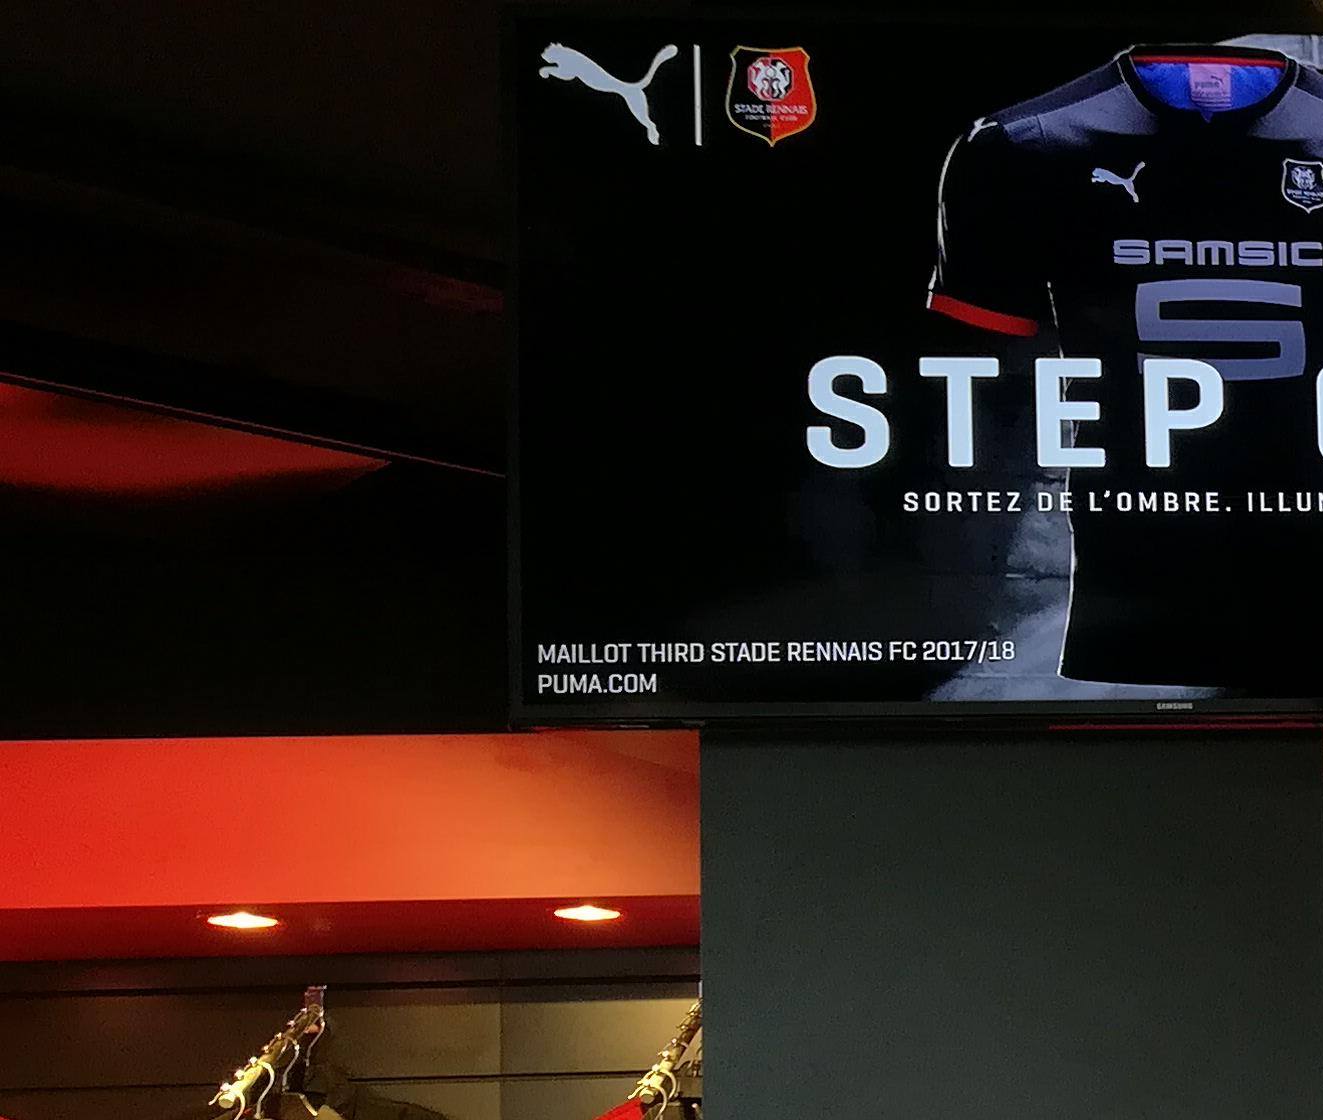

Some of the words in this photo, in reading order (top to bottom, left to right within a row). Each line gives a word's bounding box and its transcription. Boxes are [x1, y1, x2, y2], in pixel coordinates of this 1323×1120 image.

[1113, 239, 1323, 267] SAMSIC
[806, 355, 1225, 468] STEP
[903, 492, 1022, 512] SORTEZ
[1037, 492, 1073, 512] DE
[1089, 490, 1232, 512] L'OMBRE.
[538, 643, 632, 663] MAILLOT
[637, 643, 705, 663] THIRD
[711, 642, 780, 663] STADE
[787, 641, 883, 662] RENNAIS
[889, 641, 917, 661] FC
[922, 640, 1017, 664] 2017/18
[538, 673, 657, 694] PUMA.COM
